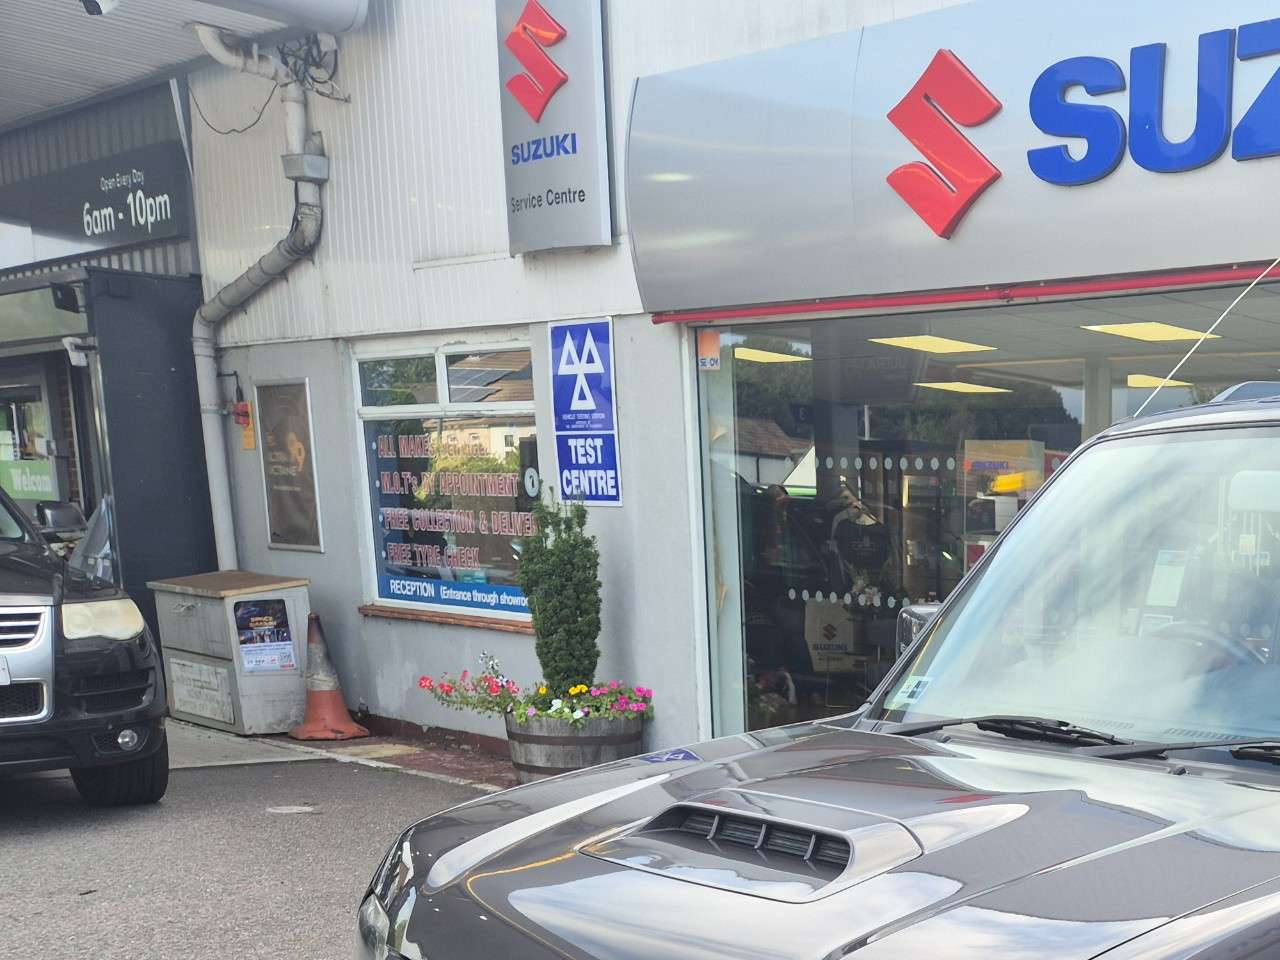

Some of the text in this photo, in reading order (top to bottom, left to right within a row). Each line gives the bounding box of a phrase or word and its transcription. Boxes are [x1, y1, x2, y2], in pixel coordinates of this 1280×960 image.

[511, 132, 577, 166] SUZUKI
[83, 202, 115, 236] 6am
[126, 189, 171, 234] 10pm
[511, 187, 586, 213] Service Centre
[378, 434, 396, 458] ALL
[399, 434, 436, 458] MAKES
[567, 437, 603, 465] TEST
[421, 472, 435, 495] BY
[440, 472, 519, 497] APPOINTMENT
[562, 469, 617, 496] CENTRE
[384, 508, 410, 531] FREE
[412, 508, 475, 534] COLLECTION
[479, 511, 489, 534] &
[387, 543, 481, 570] FREE TYRE CHECK
[390, 580, 434, 598] RECEPTION
[440, 585, 472, 602] (Entrance
[473, 588, 499, 606] through
